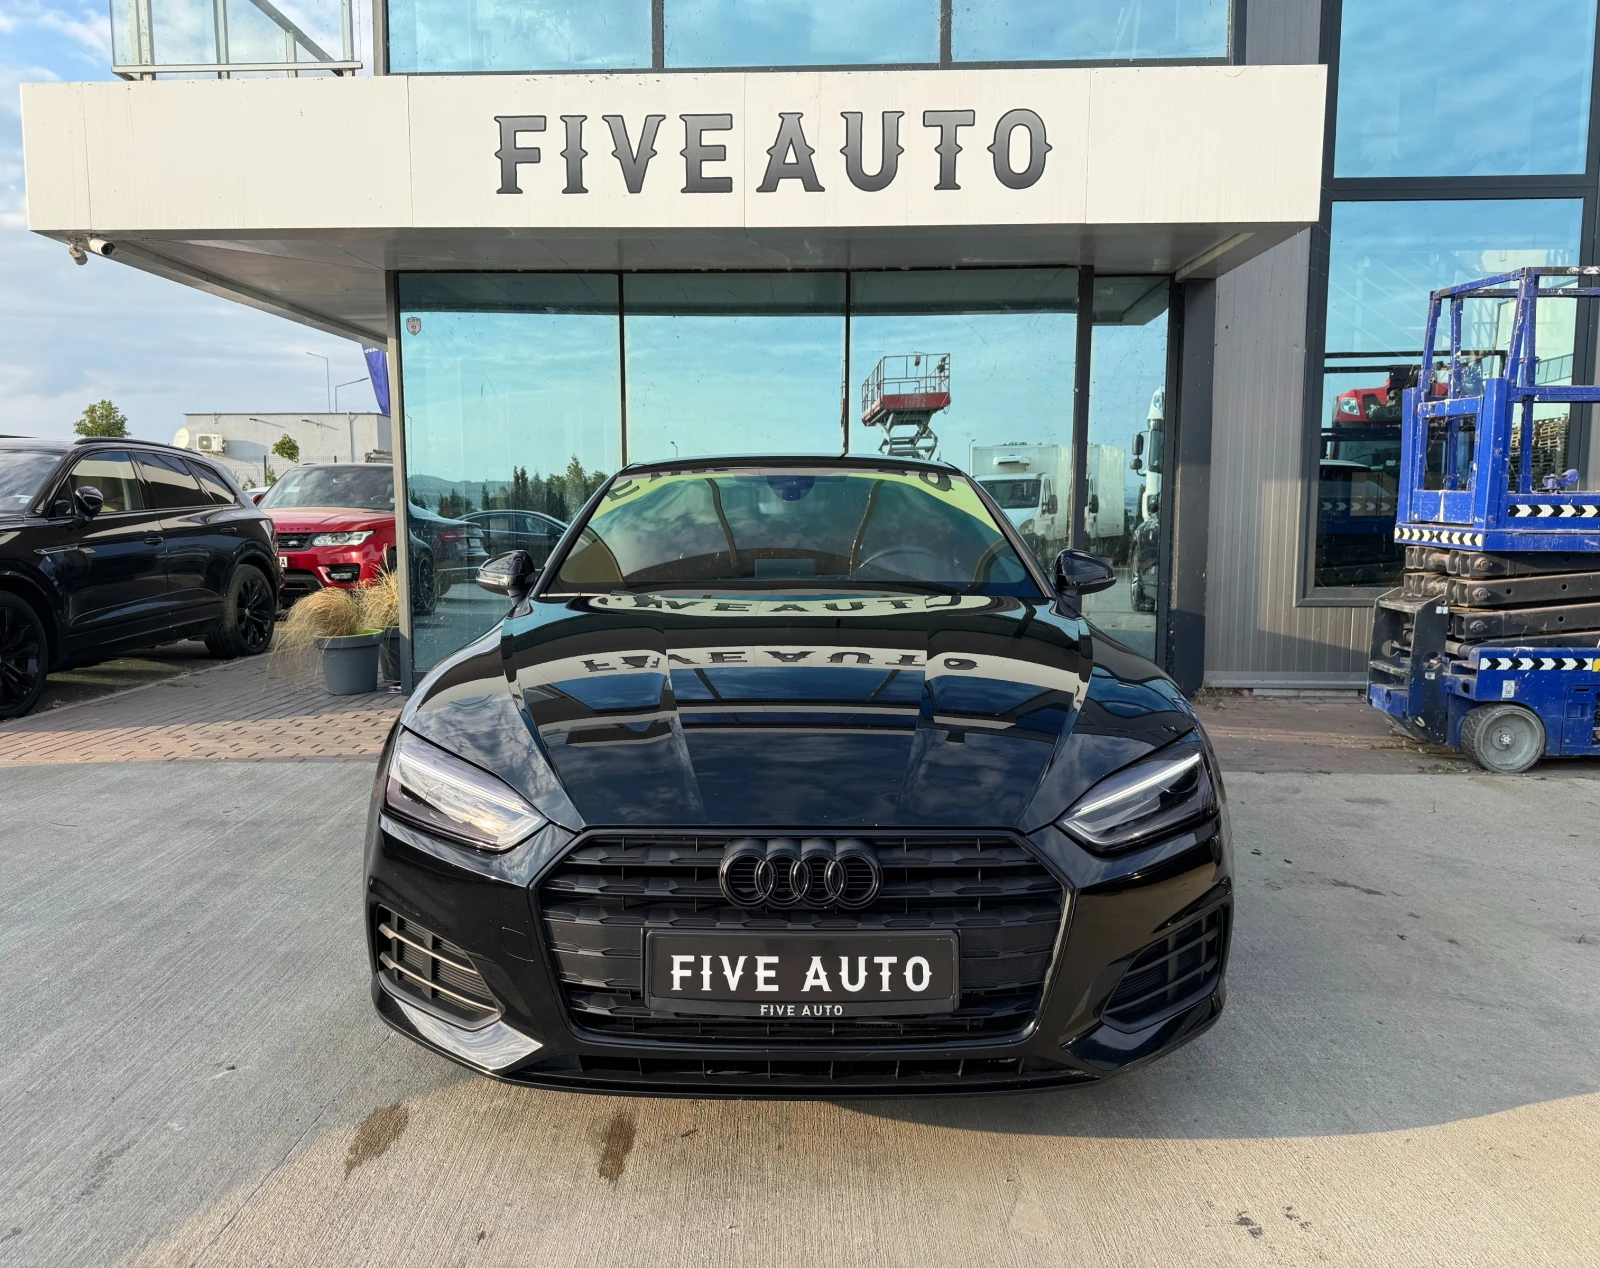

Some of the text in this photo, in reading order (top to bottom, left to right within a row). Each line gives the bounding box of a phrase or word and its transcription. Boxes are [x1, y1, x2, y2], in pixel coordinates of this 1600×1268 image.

[670, 954, 933, 993] FIVE AUTO
[759, 1004, 844, 1017] FIVE AUTO
